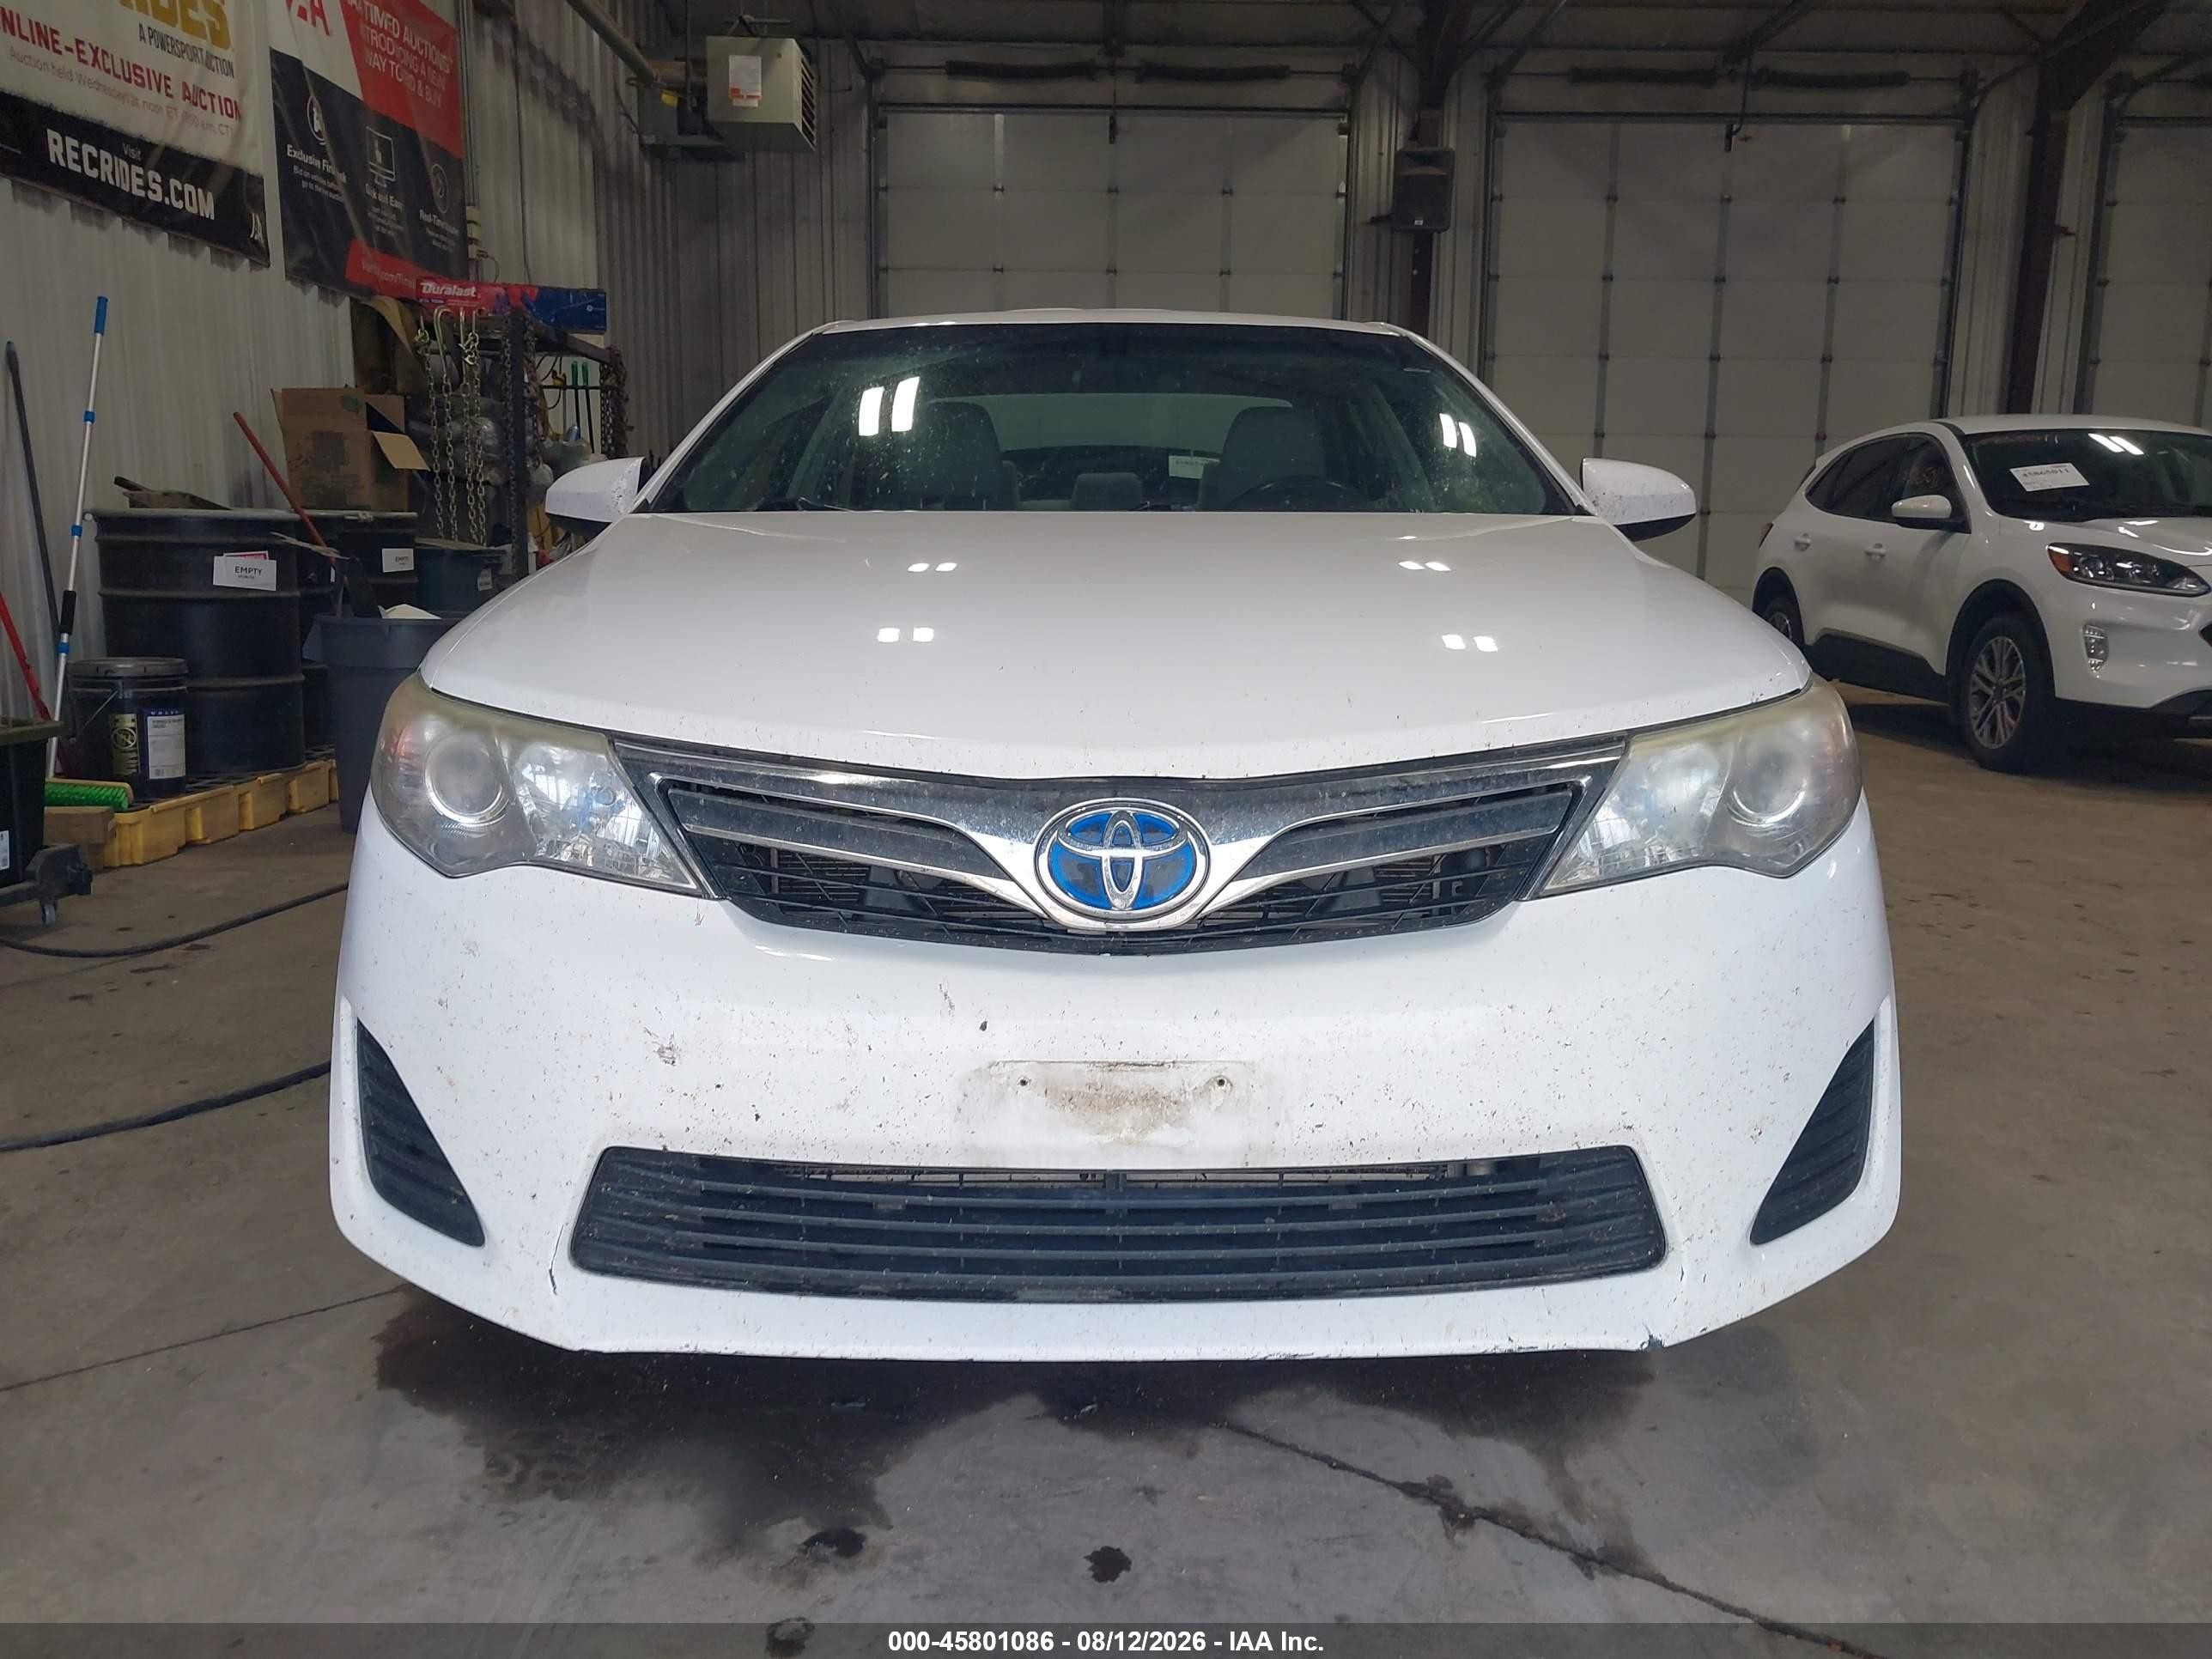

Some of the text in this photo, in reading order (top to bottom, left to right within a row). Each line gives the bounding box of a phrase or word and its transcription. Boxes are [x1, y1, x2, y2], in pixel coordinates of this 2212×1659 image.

[0, 7, 241, 122] NLINE-EXCLUSIVE AUCTION
[138, 22, 234, 79] A POWERSPORT UCTION
[9, 46, 51, 72] Auction
[166, 105, 179, 118] ET
[46, 129, 215, 221] RECRIDES.COM
[122, 142, 142, 161] Visit
[420, 282, 477, 297] Duralast
[234, 566, 263, 576] EMPTY
